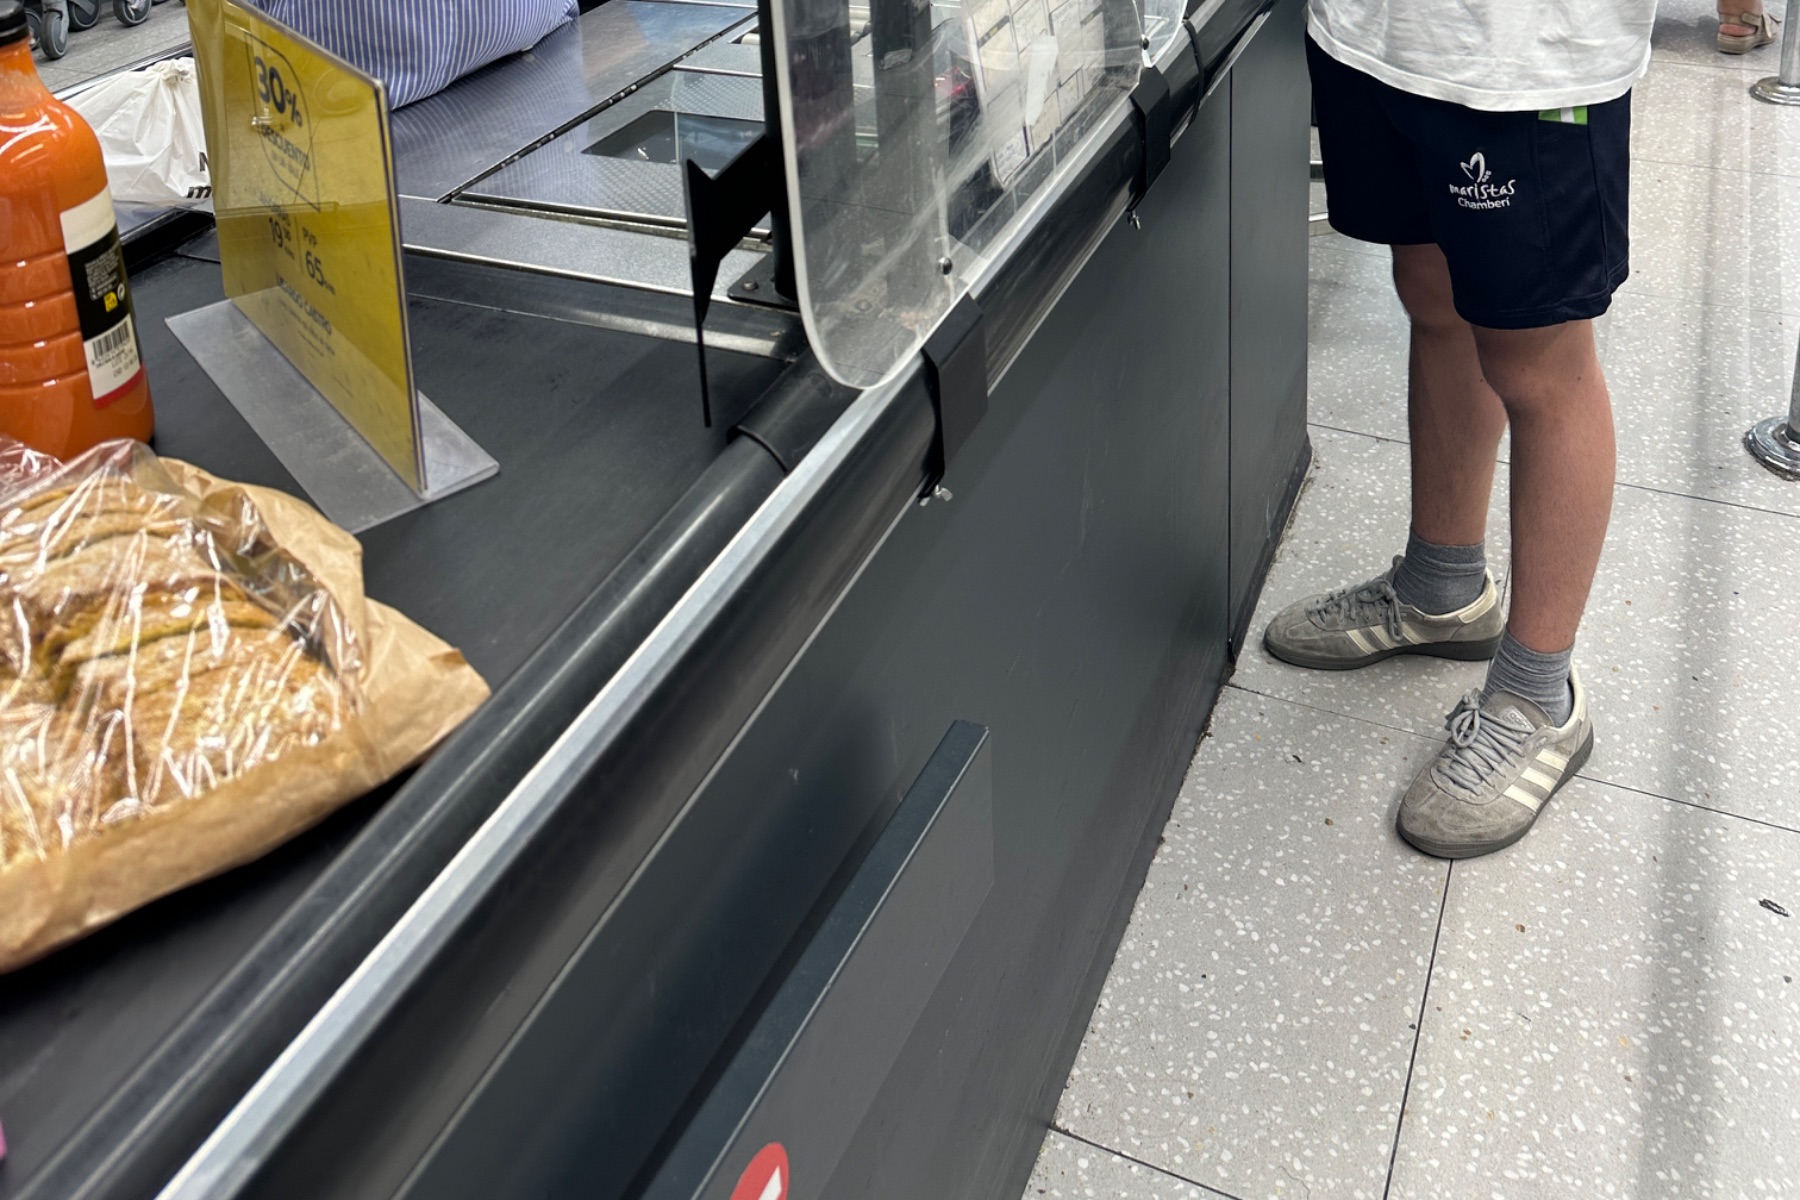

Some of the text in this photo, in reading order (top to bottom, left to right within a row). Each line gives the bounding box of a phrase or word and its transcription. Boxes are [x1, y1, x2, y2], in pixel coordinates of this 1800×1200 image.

[254, 56, 303, 127] 30%
[1449, 179, 1516, 199] maristas
[305, 251, 325, 286] 65
